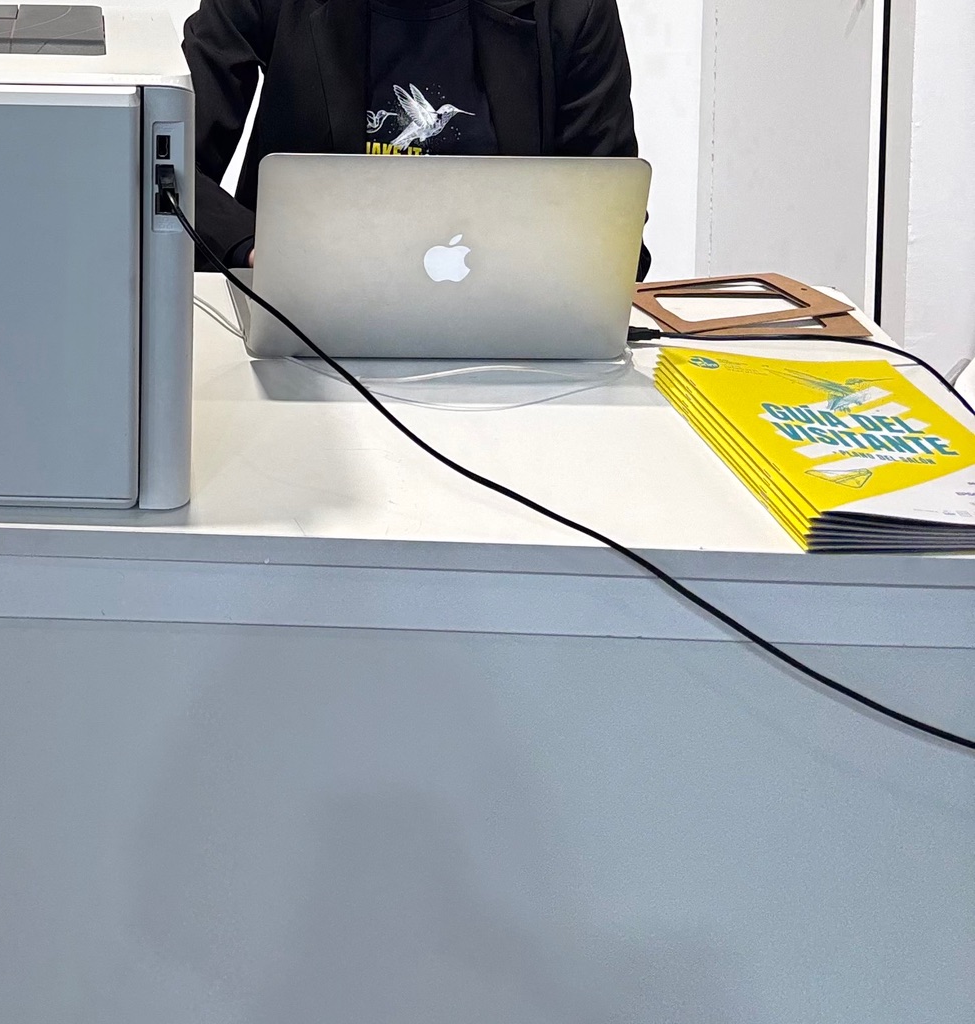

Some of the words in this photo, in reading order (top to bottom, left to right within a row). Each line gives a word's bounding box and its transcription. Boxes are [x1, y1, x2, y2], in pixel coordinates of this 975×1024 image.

[762, 402, 850, 429] GUÍA
[849, 413, 925, 434] DEL
[772, 422, 960, 456] VISITANTE
[839, 449, 875, 459] PLANO
